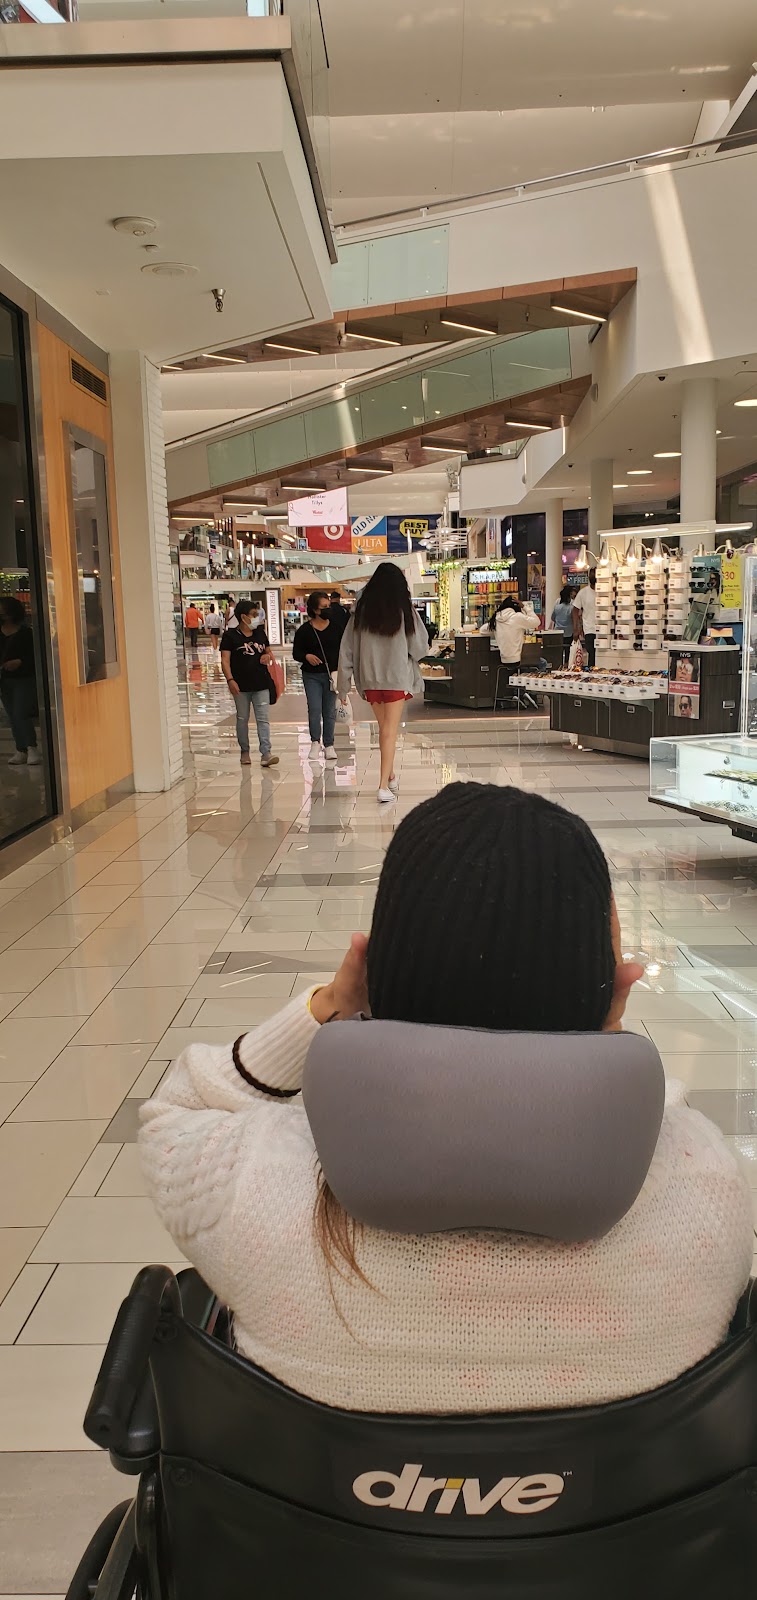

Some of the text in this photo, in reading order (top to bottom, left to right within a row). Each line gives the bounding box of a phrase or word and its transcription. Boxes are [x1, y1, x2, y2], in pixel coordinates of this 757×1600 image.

[353, 521, 366, 535] OLD
[355, 538, 383, 549] ULTA
[574, 576, 589, 584] FREE
[352, 1463, 564, 1515] drive
